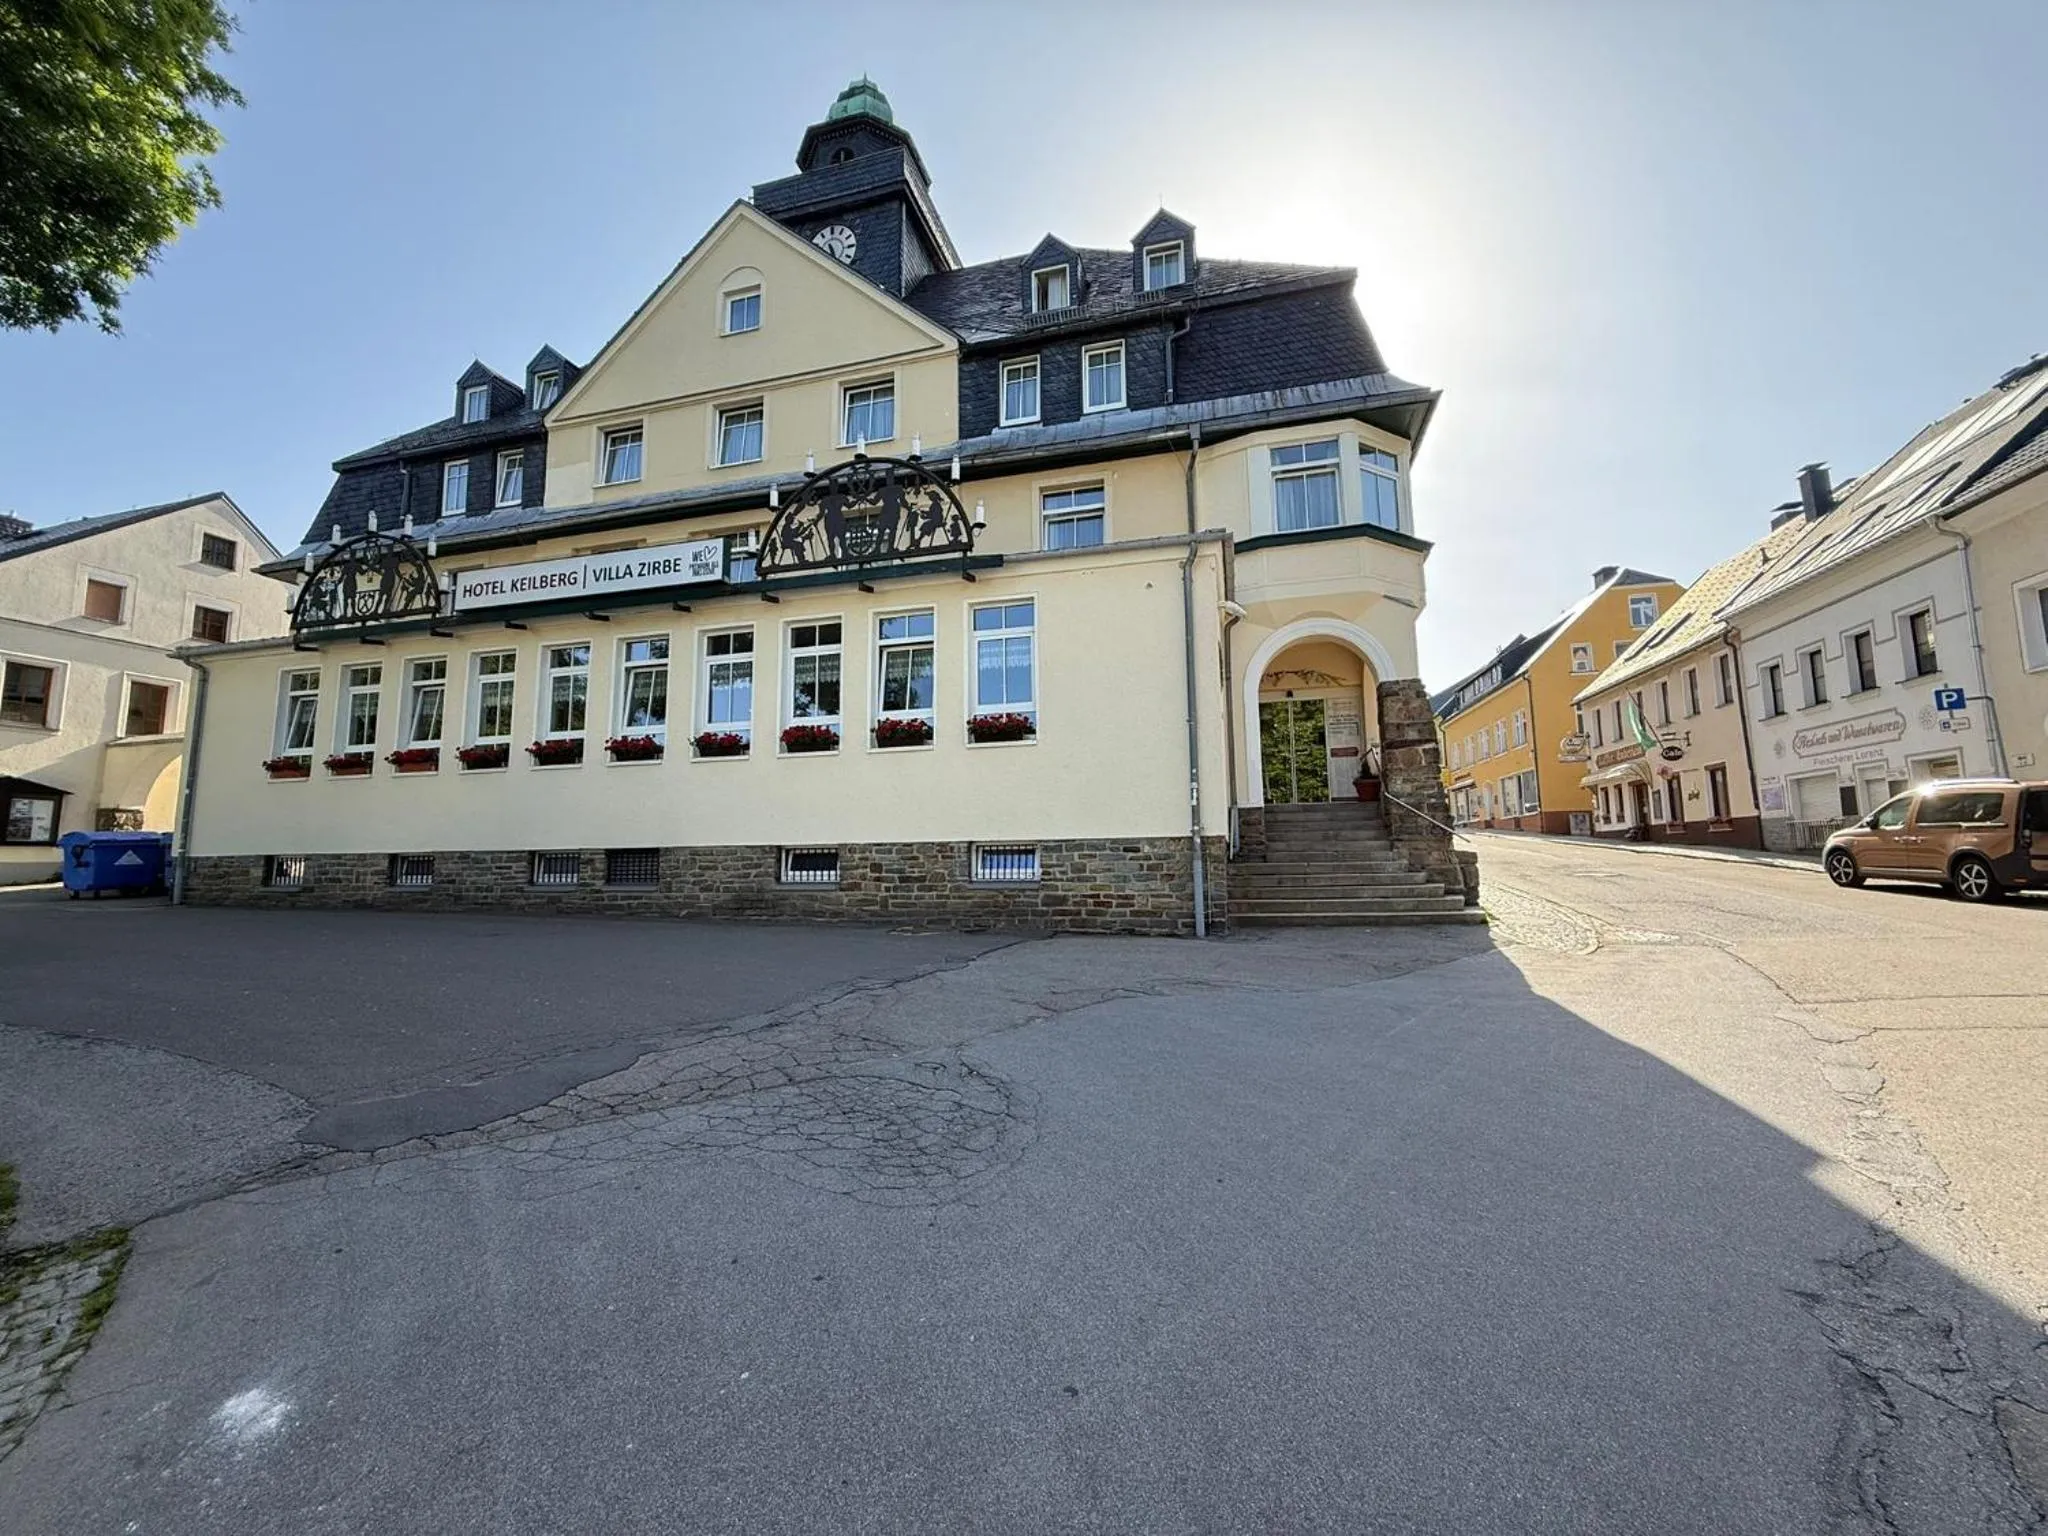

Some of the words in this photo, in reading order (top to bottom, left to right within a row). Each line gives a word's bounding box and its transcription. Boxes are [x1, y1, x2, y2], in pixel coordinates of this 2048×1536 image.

[463, 580, 506, 598] HOTEL
[510, 571, 578, 593] KEILBERG
[592, 565, 633, 583] VILLA
[638, 558, 682, 577] ZIRBE
[1941, 692, 1958, 708] P
[1855, 748, 1884, 760] Lorenz
